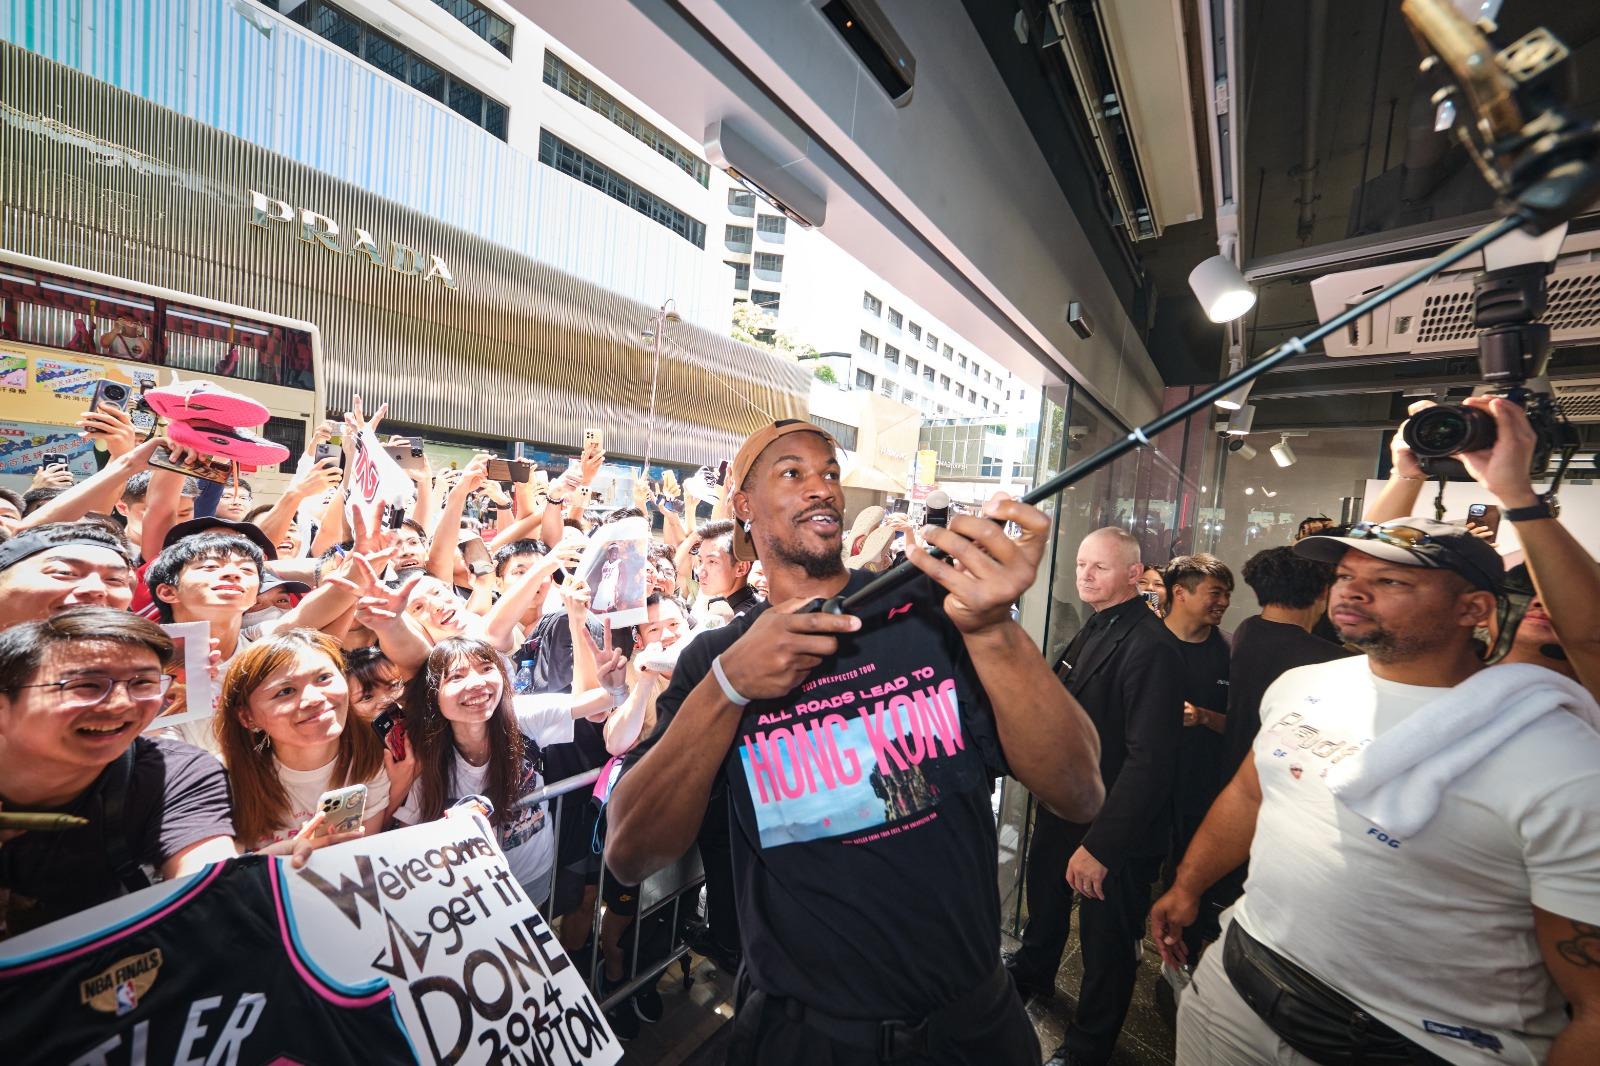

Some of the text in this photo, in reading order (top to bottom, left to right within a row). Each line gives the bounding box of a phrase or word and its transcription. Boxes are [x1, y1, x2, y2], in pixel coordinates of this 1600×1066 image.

[249, 189, 458, 290] PRADA
[757, 666, 935, 726] ALL ROADS LEAD TO
[818, 669, 858, 686] UNEXPECTED
[859, 663, 876, 675] TOUR
[743, 713, 862, 804] HONG
[1366, 828, 1401, 848] FOG
[428, 865, 522, 955] get it
[84, 950, 160, 999] NBA FINALS
[409, 913, 570, 1066] DONE
[478, 980, 562, 1066] 2024
